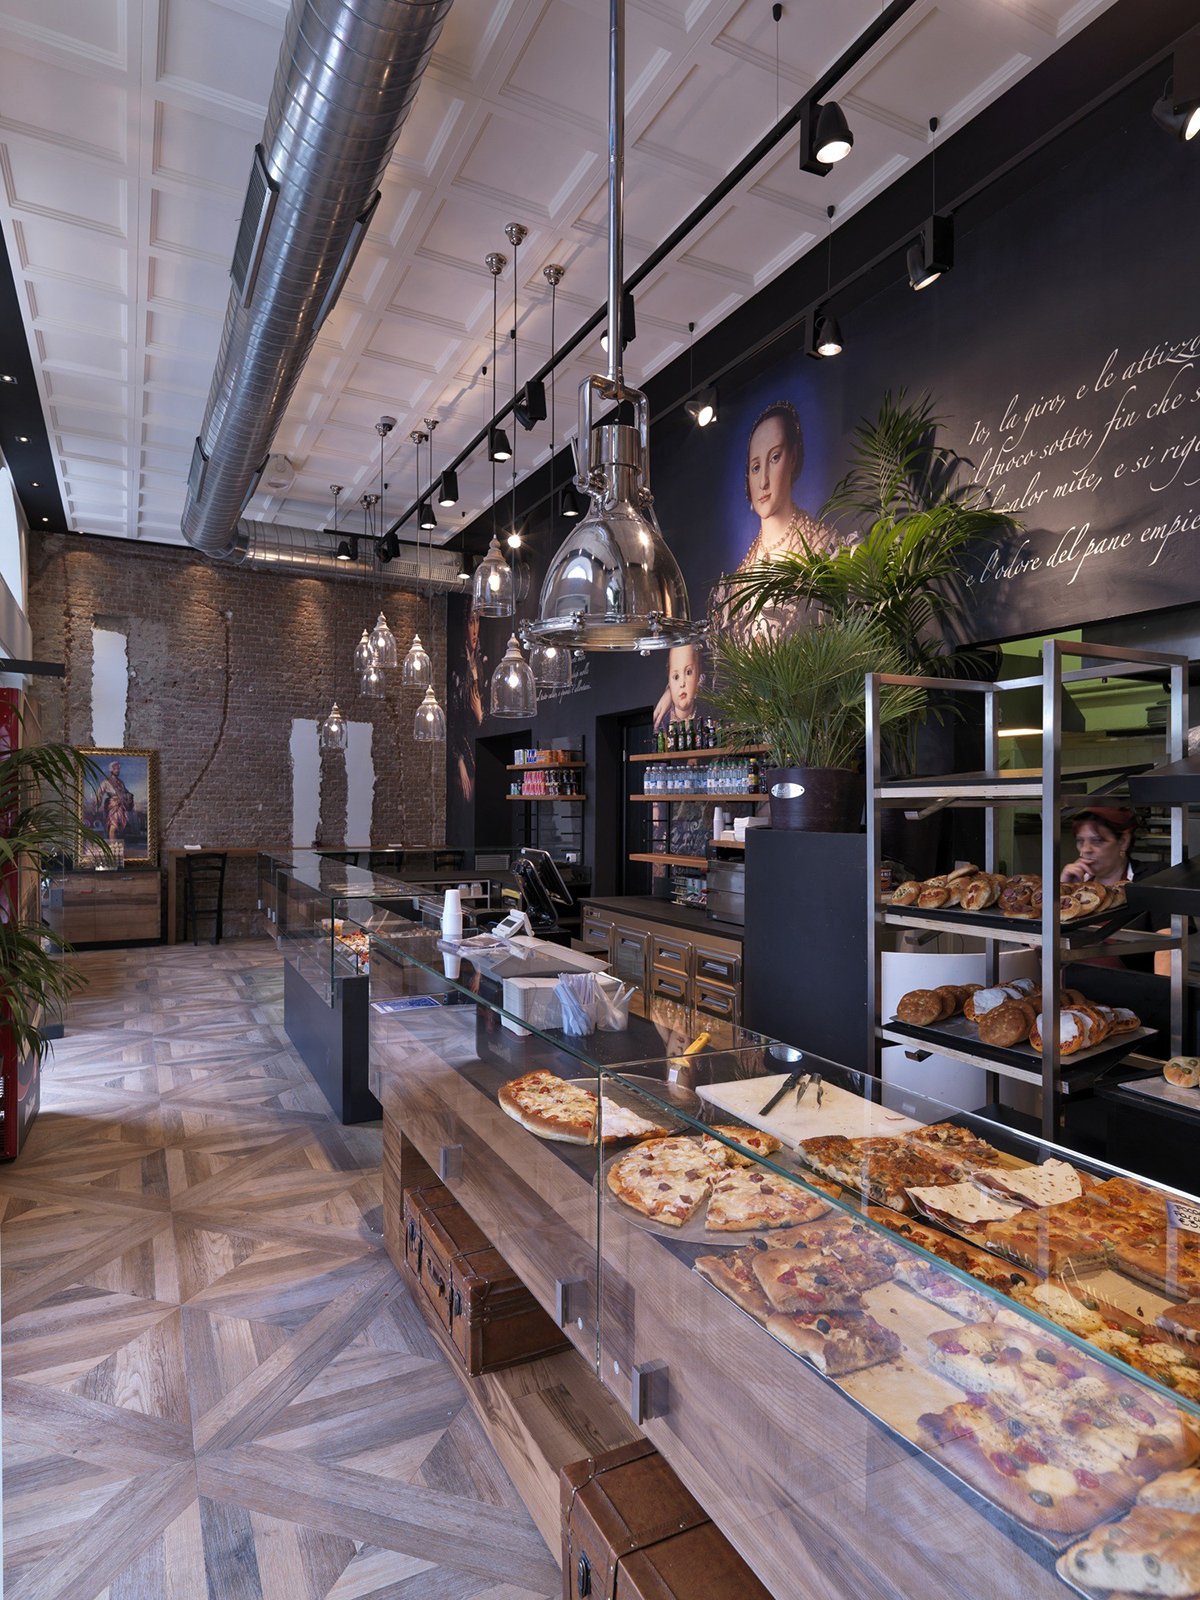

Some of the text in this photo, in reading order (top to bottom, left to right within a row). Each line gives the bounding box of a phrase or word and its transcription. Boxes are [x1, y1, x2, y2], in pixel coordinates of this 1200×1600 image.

[999, 394, 1021, 432] la
[1075, 384, 1090, 400] e
[1094, 348, 1118, 392] le
[1039, 426, 1094, 460] sotto,
[1071, 385, 1140, 476] fin
[1146, 363, 1194, 419] che
[1113, 463, 1128, 478] e
[1130, 445, 1156, 473] si
[1046, 522, 1090, 568] del
[1066, 533, 1135, 586] pane
[965, 574, 976, 588] e
